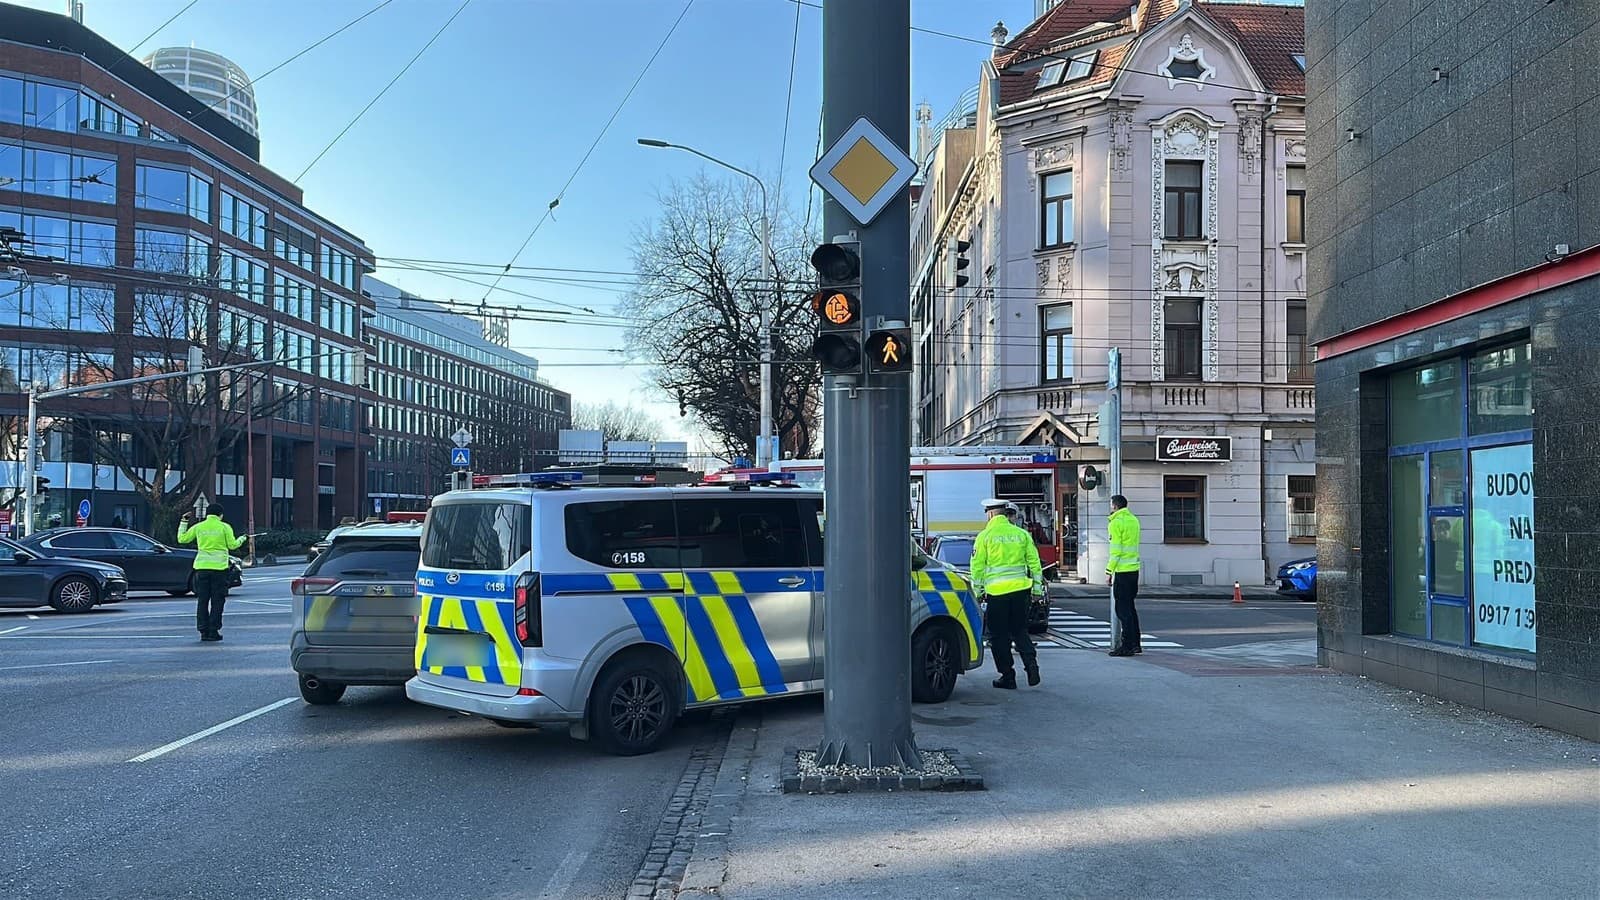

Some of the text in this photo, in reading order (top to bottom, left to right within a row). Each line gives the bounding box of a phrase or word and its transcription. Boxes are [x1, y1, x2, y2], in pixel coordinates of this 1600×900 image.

[1166, 439, 1220, 456] Budweiser
[1509, 516, 1533, 540] NA
[622, 551, 646, 564] 158
[1493, 560, 1535, 585] PRED
[490, 581, 506, 592] 158
[1479, 603, 1510, 626] 0917
